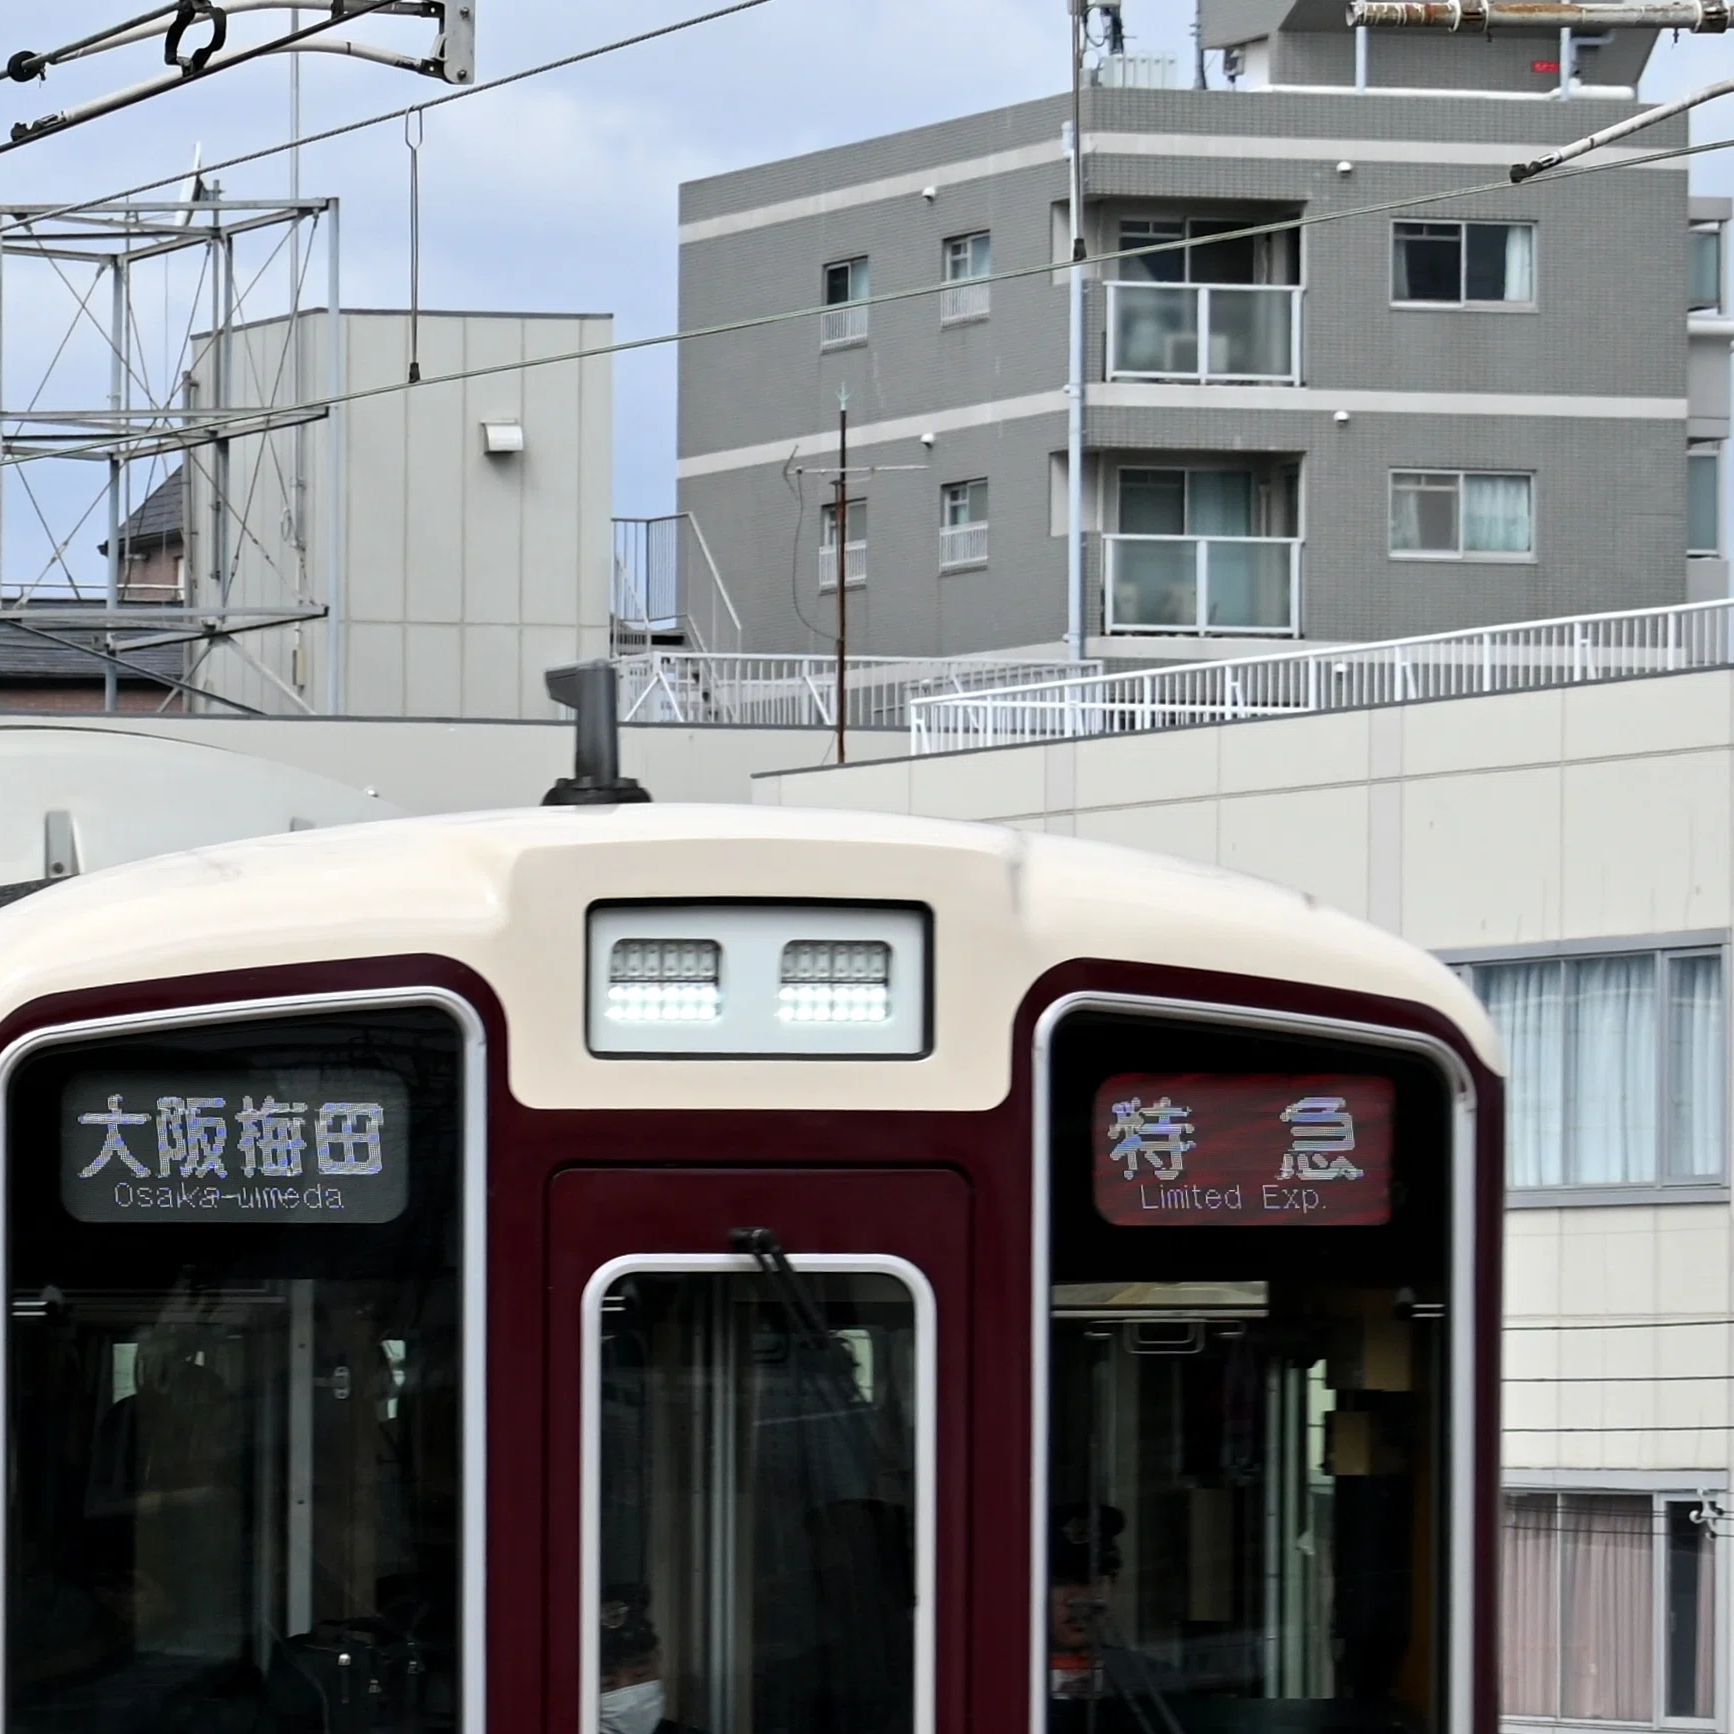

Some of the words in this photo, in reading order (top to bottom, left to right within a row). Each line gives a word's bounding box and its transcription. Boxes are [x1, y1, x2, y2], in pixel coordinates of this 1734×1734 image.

[77, 1093, 385, 1179] 大阪梅田
[1140, 1184, 1243, 1211] Limited
[1262, 1184, 1327, 1215] Exp.
